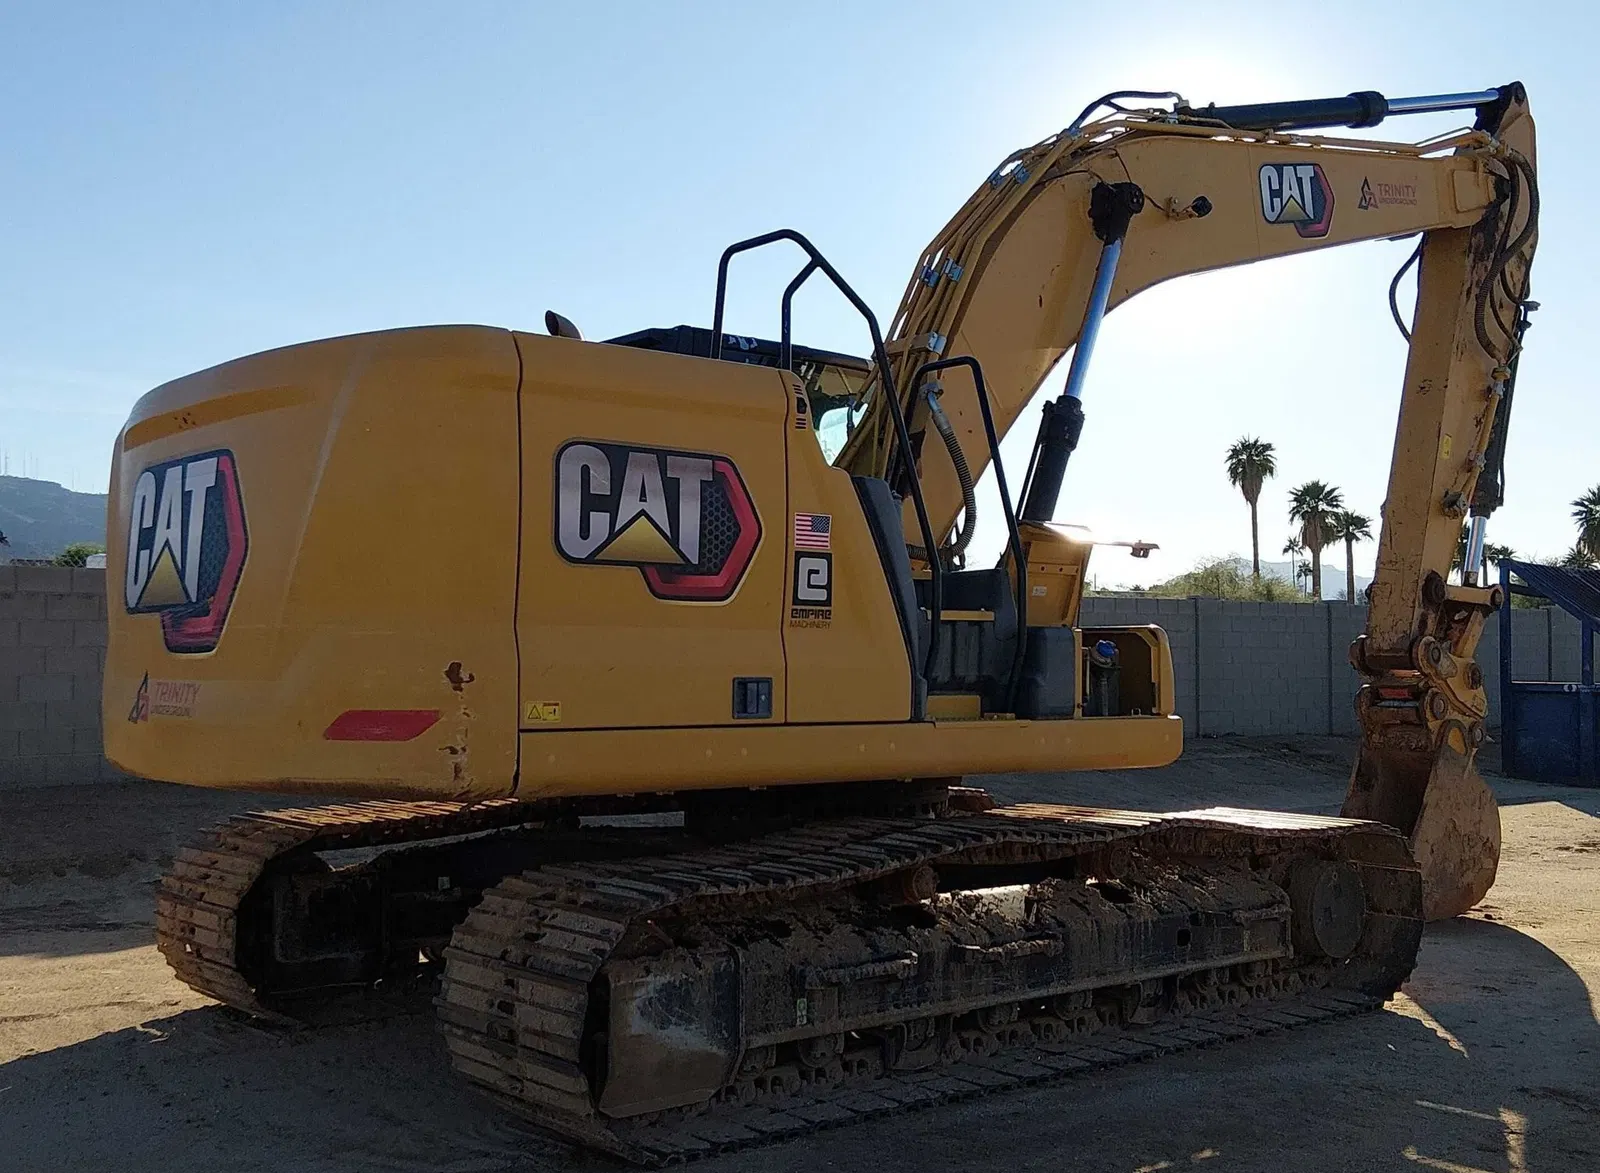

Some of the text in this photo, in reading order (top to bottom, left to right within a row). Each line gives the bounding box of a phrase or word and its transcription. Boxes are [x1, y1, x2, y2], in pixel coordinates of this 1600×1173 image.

[1260, 165, 1315, 222] CAT
[1377, 182, 1417, 198] TRINITY
[559, 444, 715, 565] CAT
[126, 456, 218, 609] CAT
[789, 619, 832, 629] MACHINERY
[155, 681, 202, 704] TRINITY
